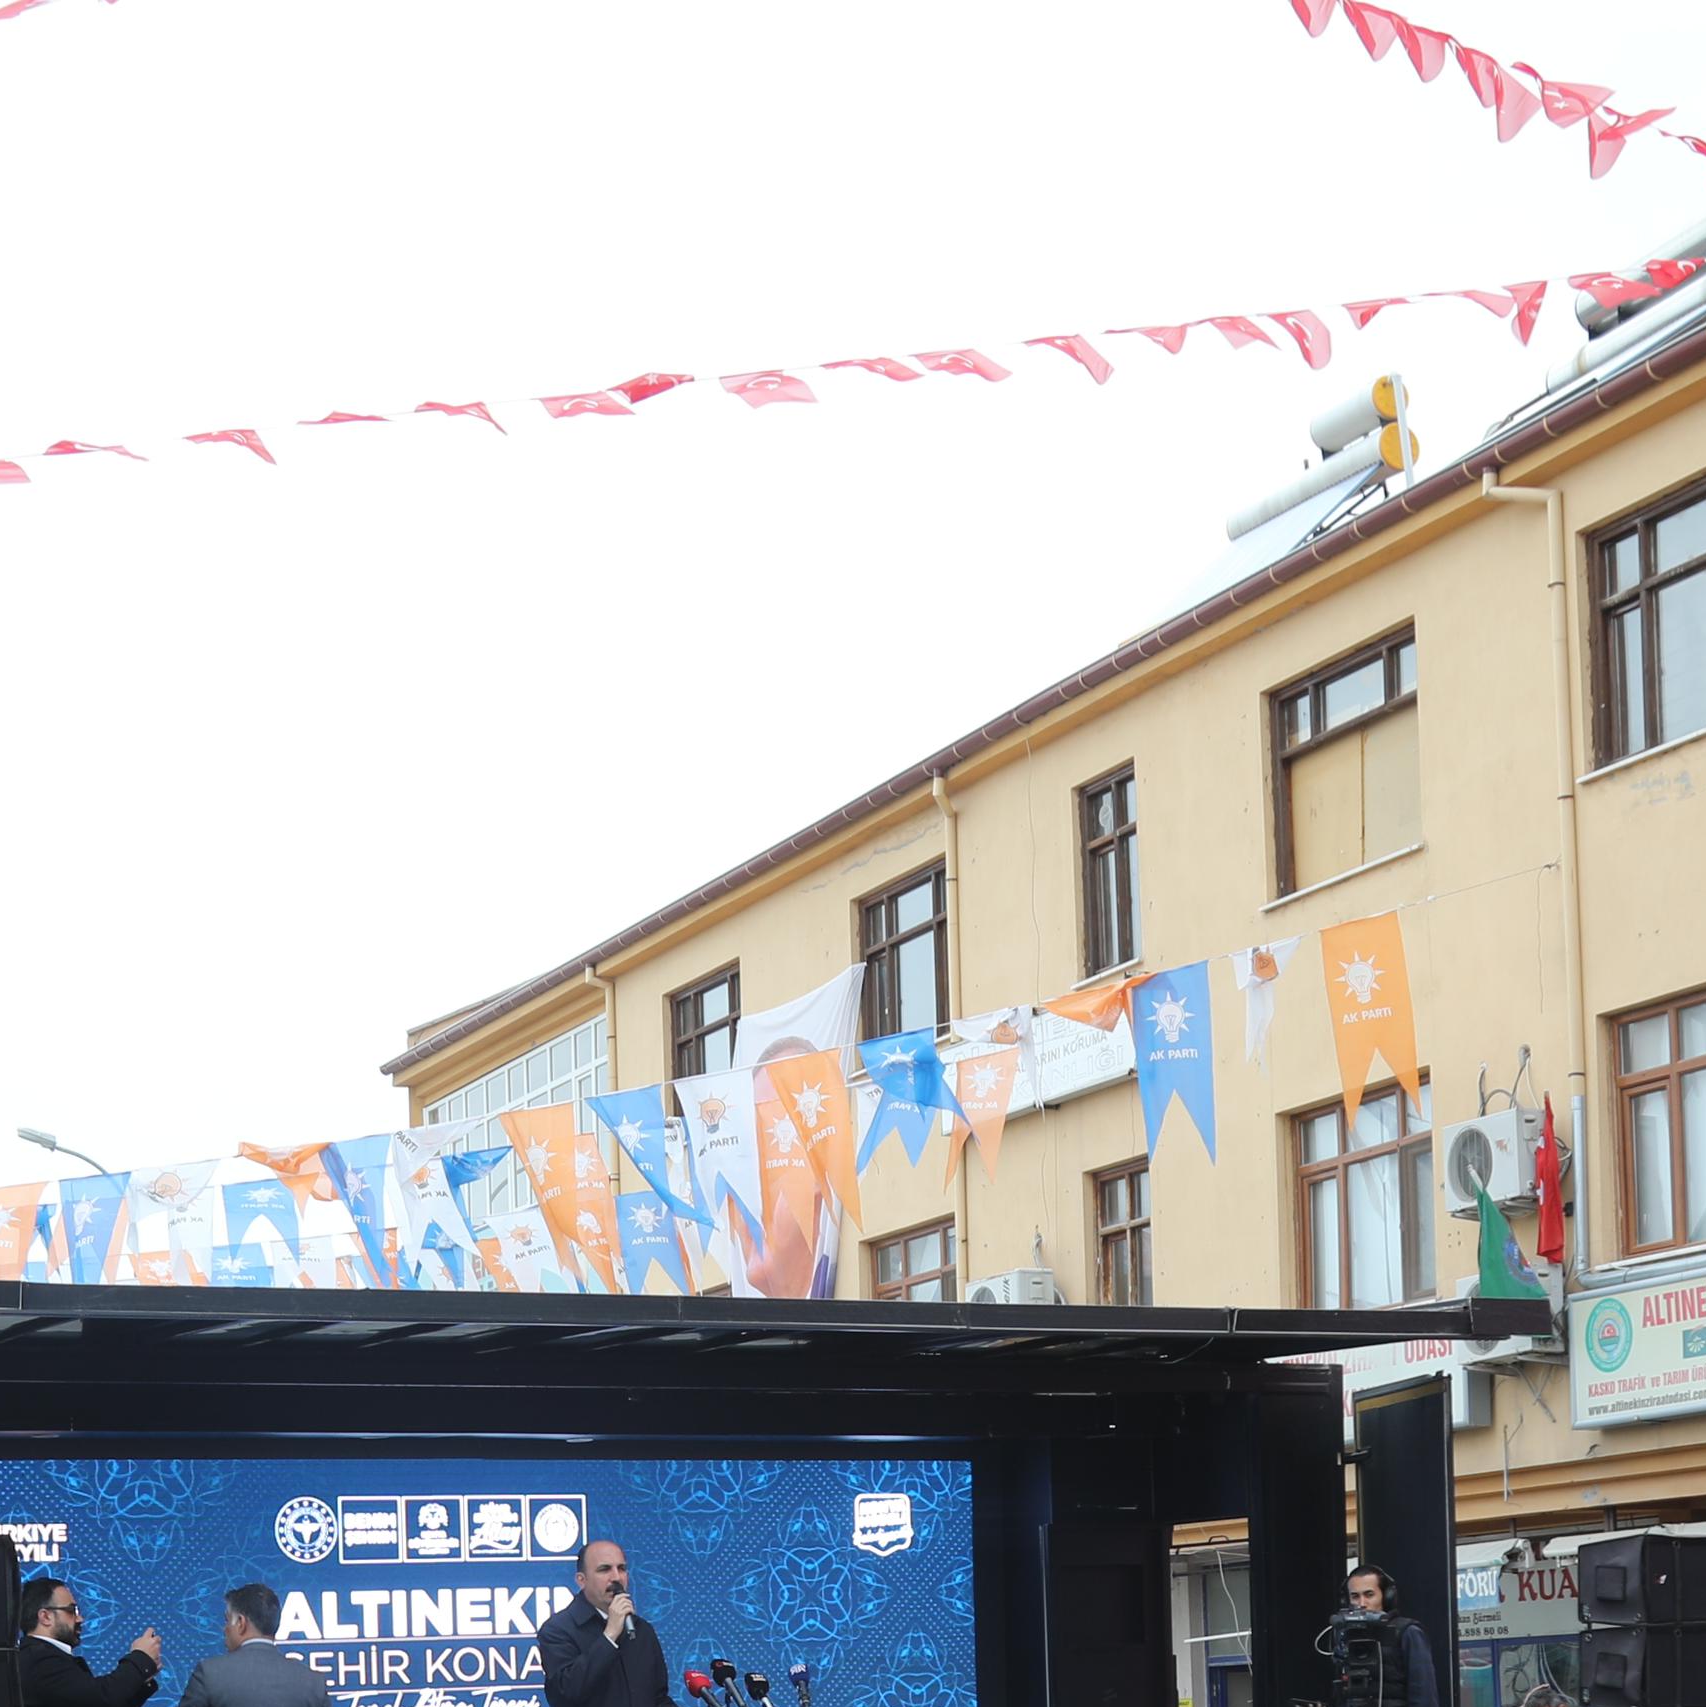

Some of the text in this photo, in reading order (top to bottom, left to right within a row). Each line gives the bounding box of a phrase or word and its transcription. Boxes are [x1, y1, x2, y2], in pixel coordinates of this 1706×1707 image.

[1342, 1012, 1358, 1024] AK
[1062, 1032, 1108, 1058] KORUMA
[1149, 1050, 1165, 1062] AK
[1588, 1381, 1616, 1398] KASKO
[1618, 1373, 1647, 1394] TRAFİK
[1651, 1376, 1661, 1388] ve
[1663, 1368, 1690, 1386] TARIM
[1457, 1567, 1579, 1602] FÖRÜ KUA
[285, 1644, 546, 1688] EHİR KONA
